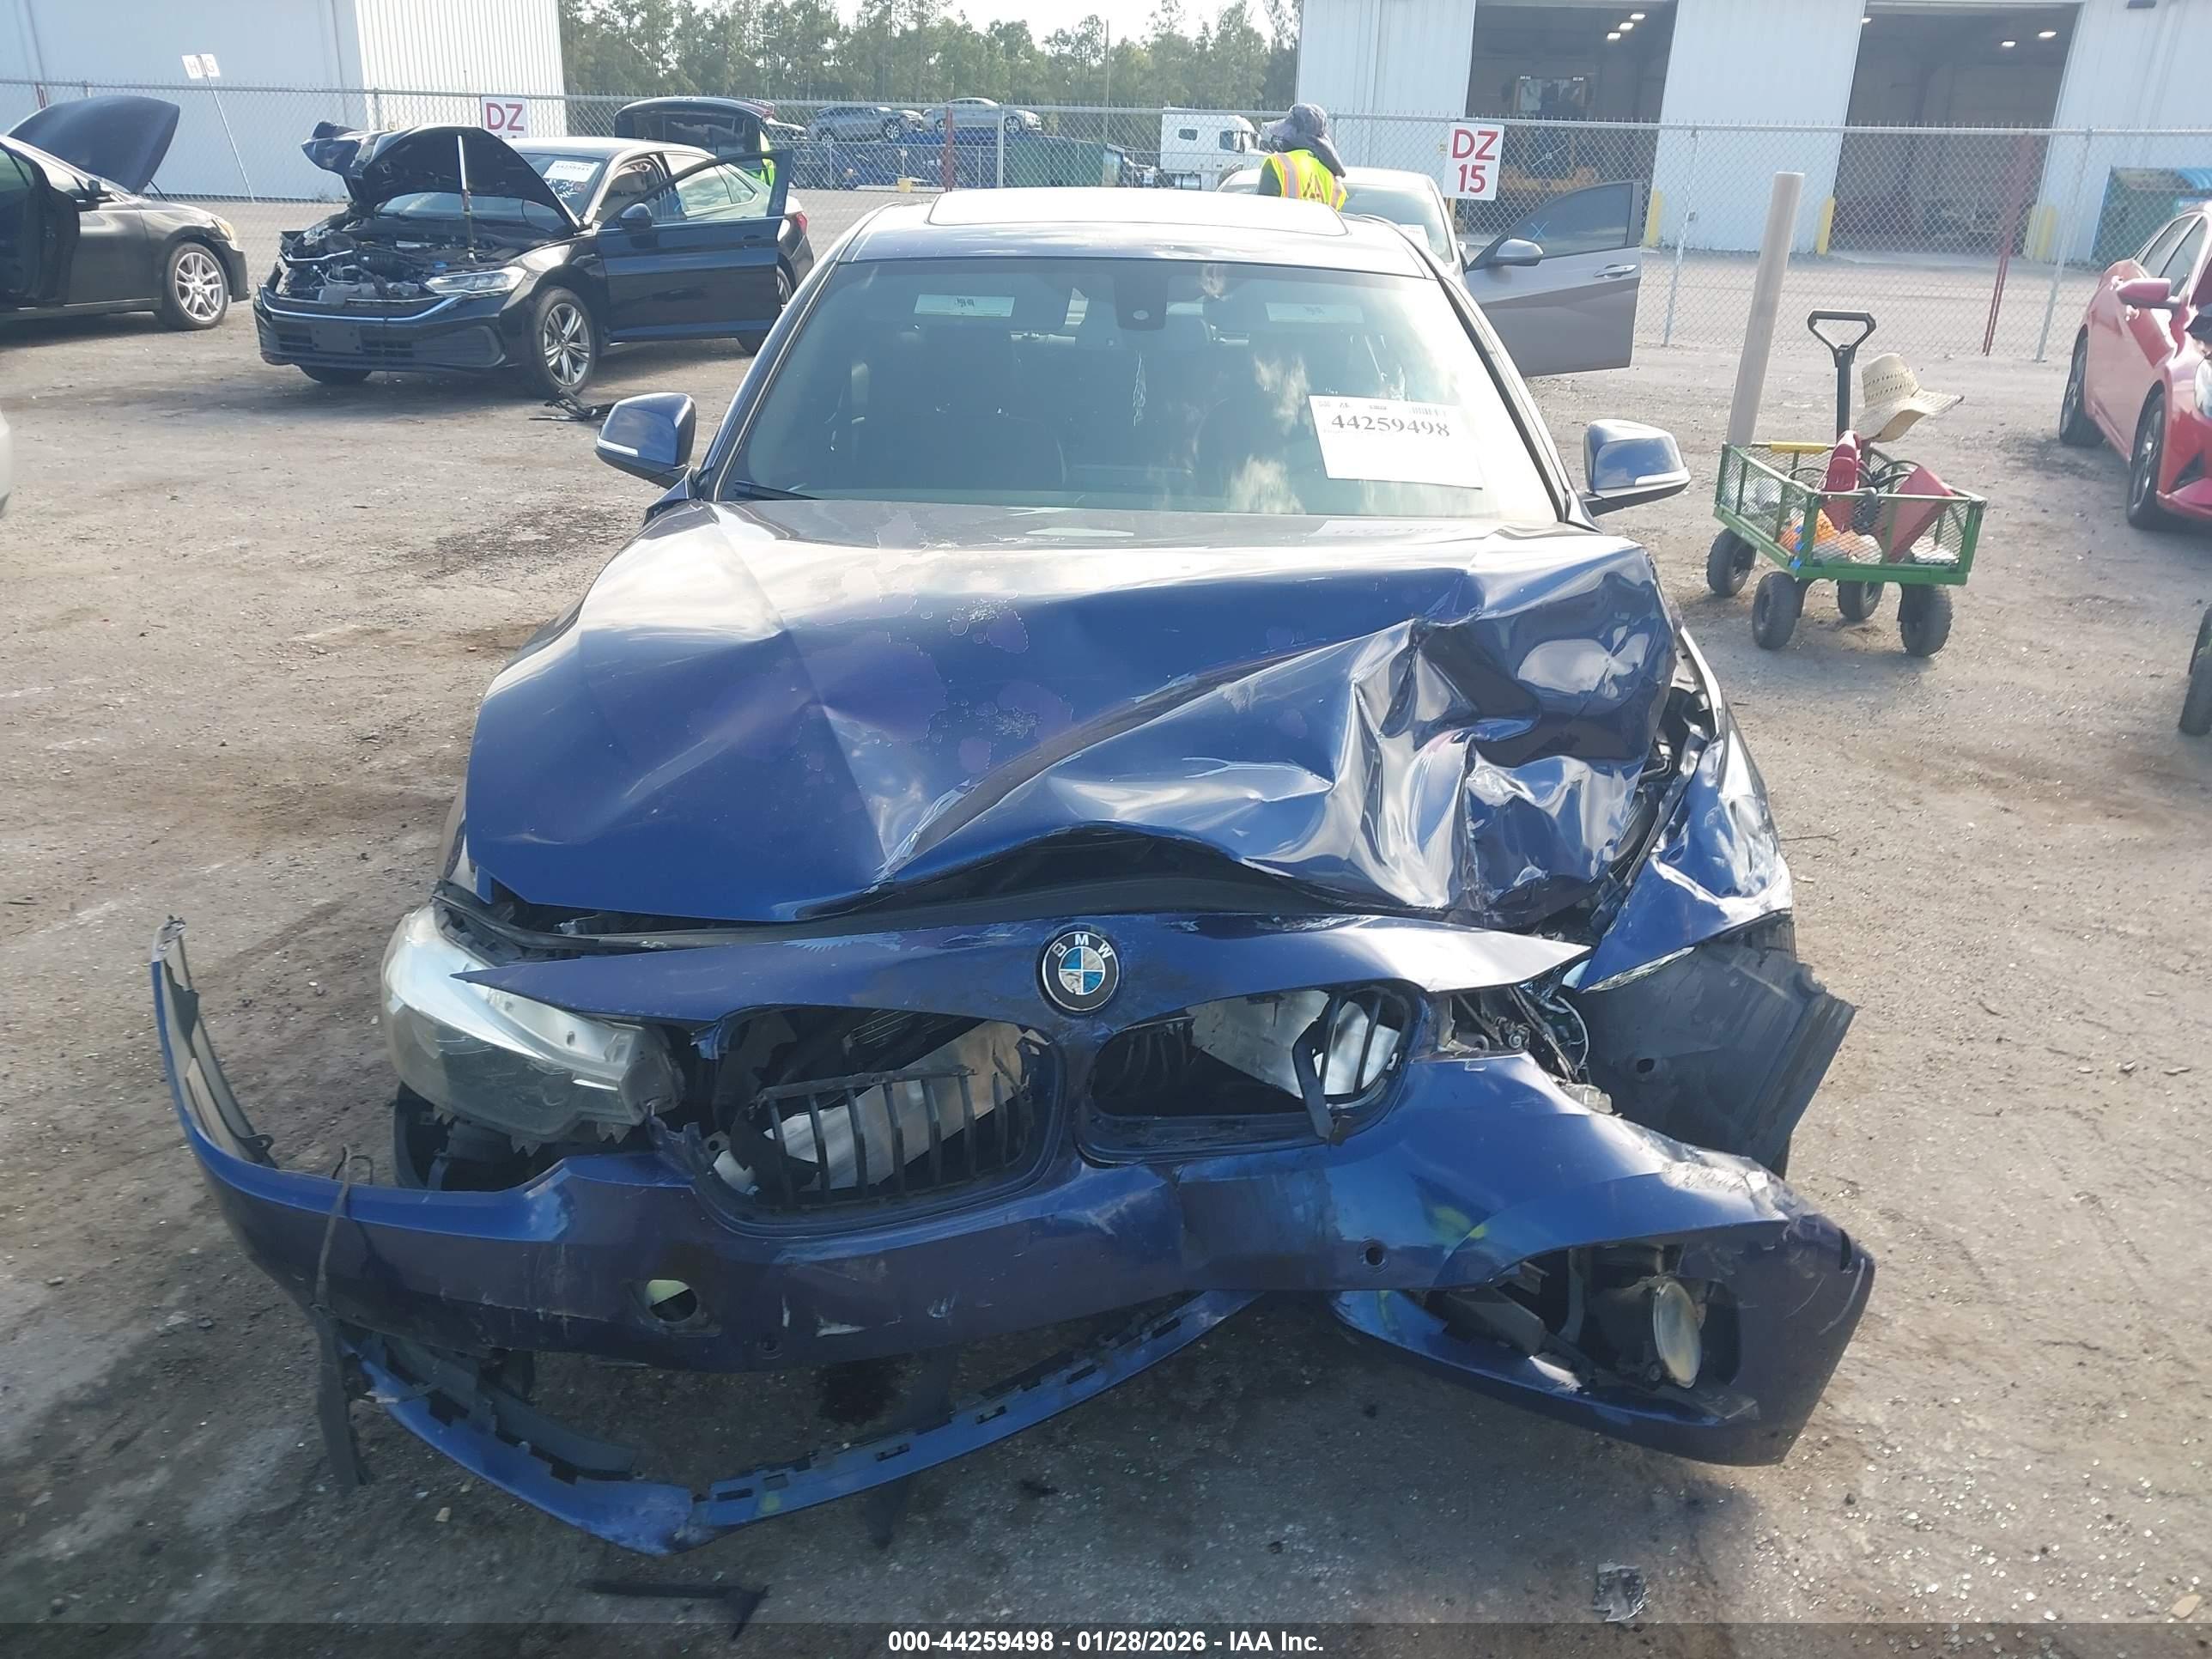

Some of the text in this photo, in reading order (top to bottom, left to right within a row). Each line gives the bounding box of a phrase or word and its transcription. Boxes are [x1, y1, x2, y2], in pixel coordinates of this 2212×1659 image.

[485, 102, 525, 131] DZ
[1452, 129, 1498, 161] DZ
[1458, 164, 1486, 193] 15
[1332, 414, 1450, 437] 44259498
[1052, 933, 1114, 959] BMW
